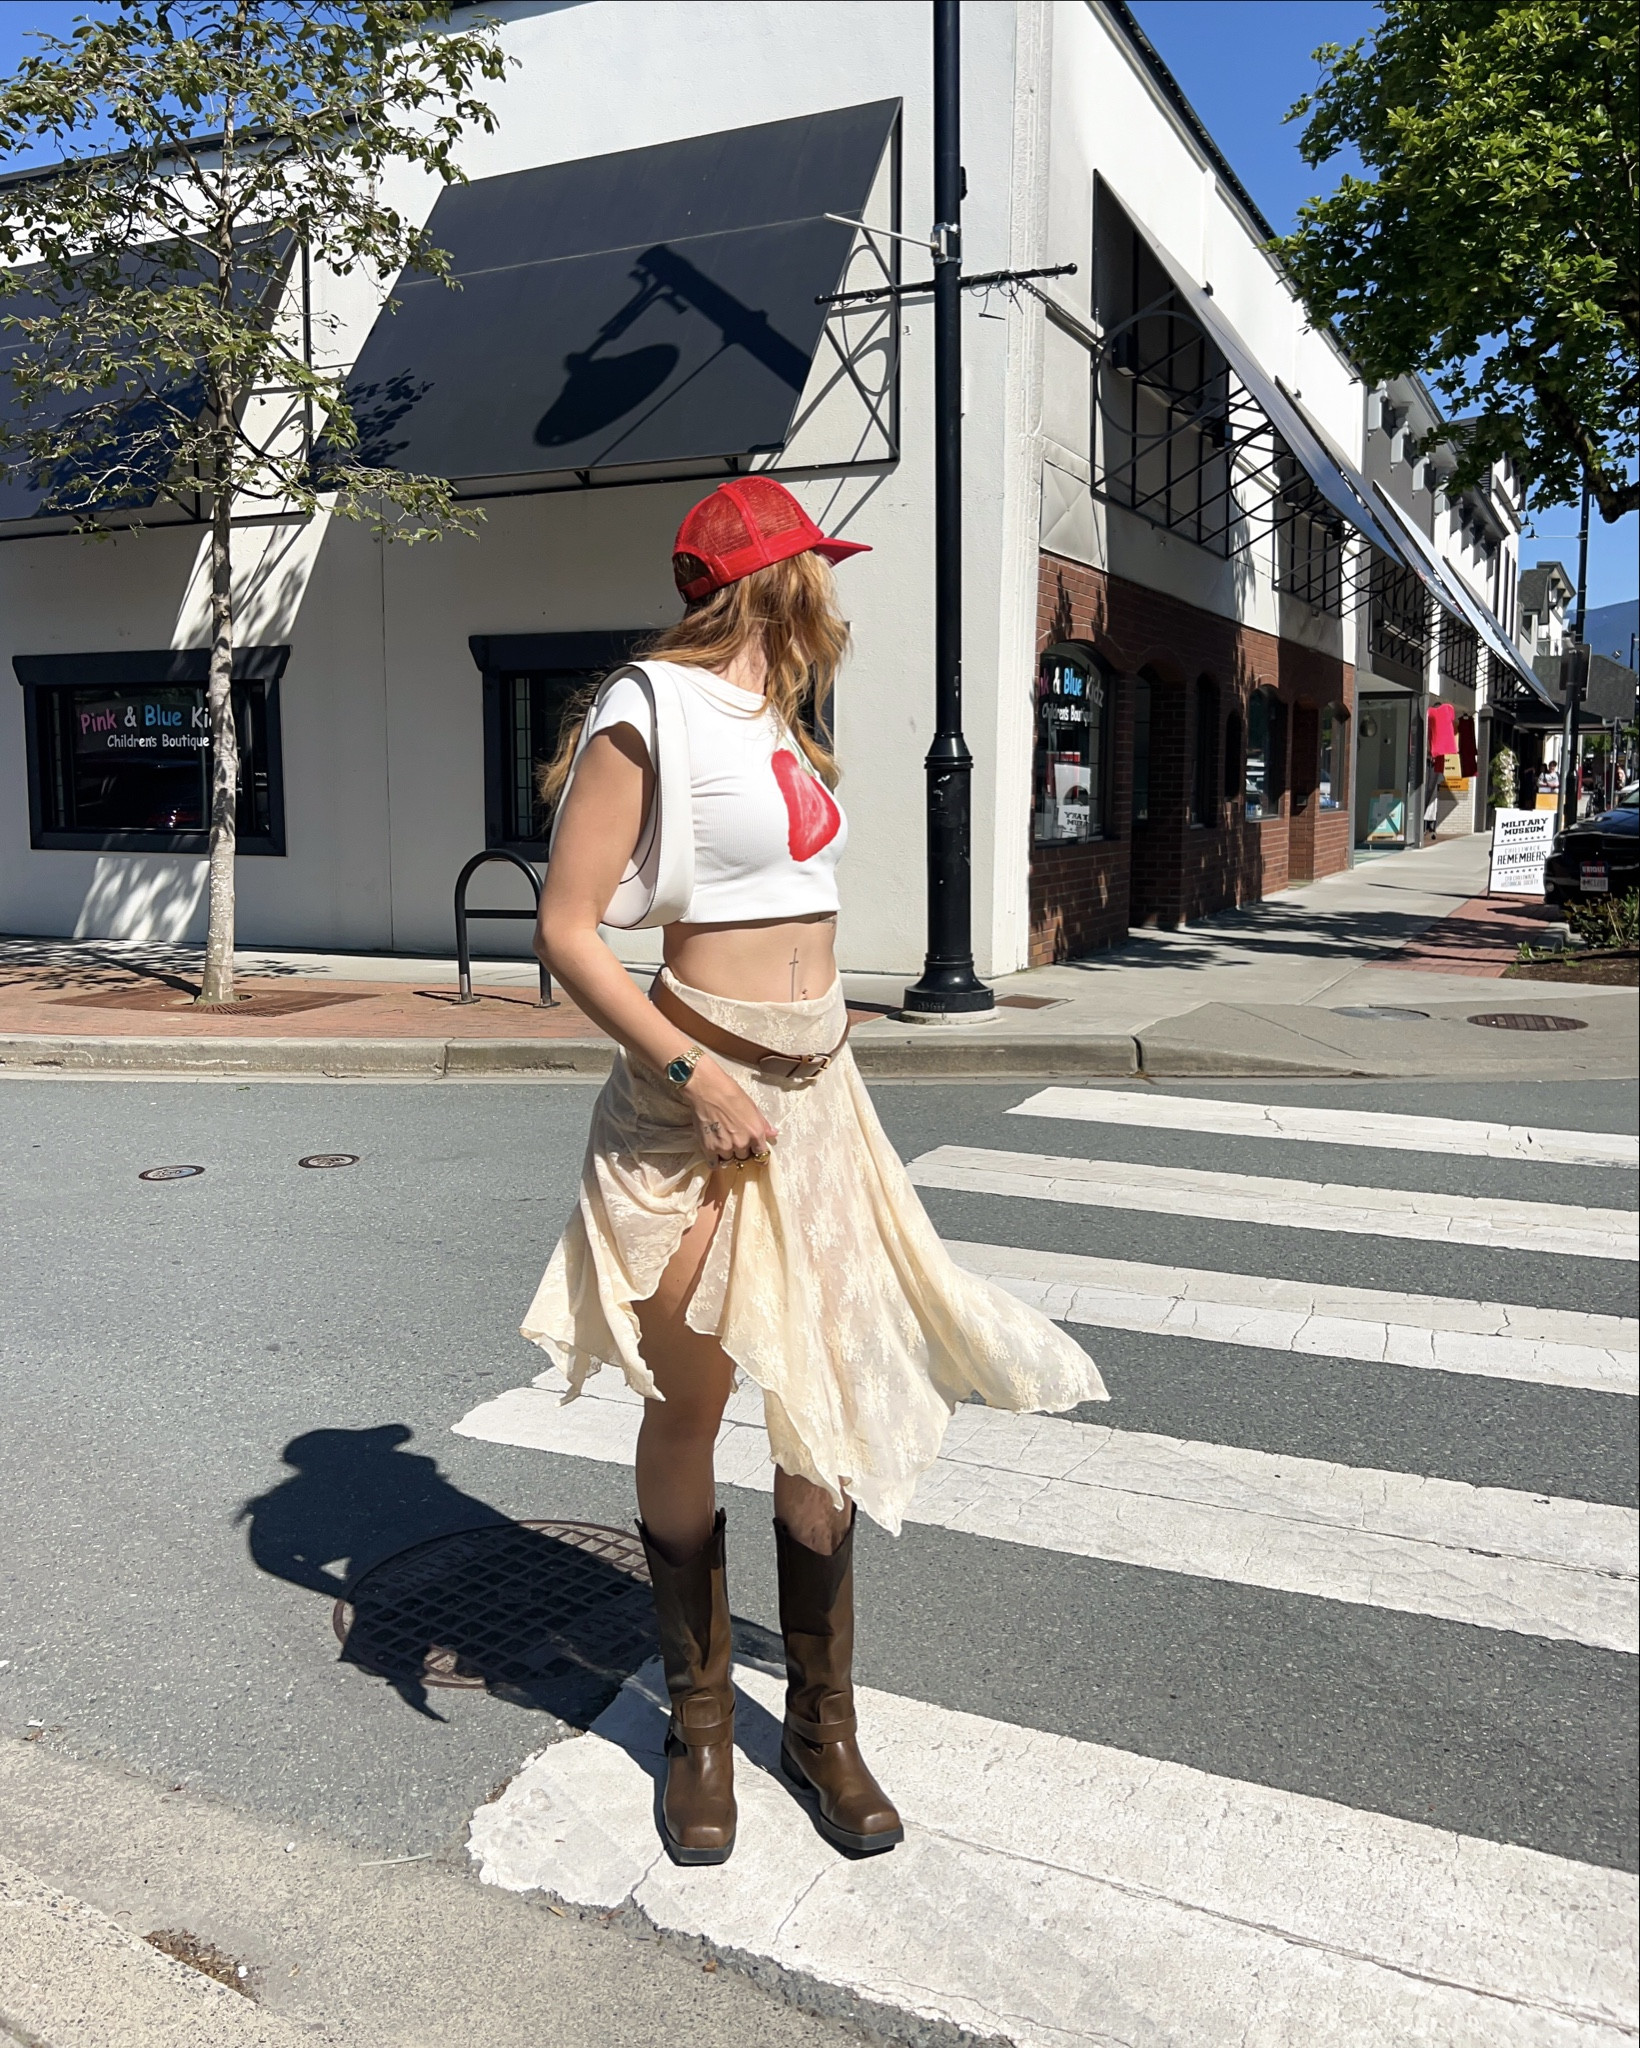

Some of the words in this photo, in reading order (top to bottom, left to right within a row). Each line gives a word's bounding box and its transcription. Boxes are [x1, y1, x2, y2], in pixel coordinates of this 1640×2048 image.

[1053, 667, 1060, 695] &
[1063, 667, 1083, 696] Blue
[81, 708, 117, 734] Pink
[124, 706, 137, 727] &
[144, 704, 182, 726] Blue
[162, 734, 210, 750] Boutique
[1501, 817, 1549, 829] MILITARY
[1504, 826, 1545, 836] MUSEUM
[1497, 851, 1547, 865] REMEMBERS
